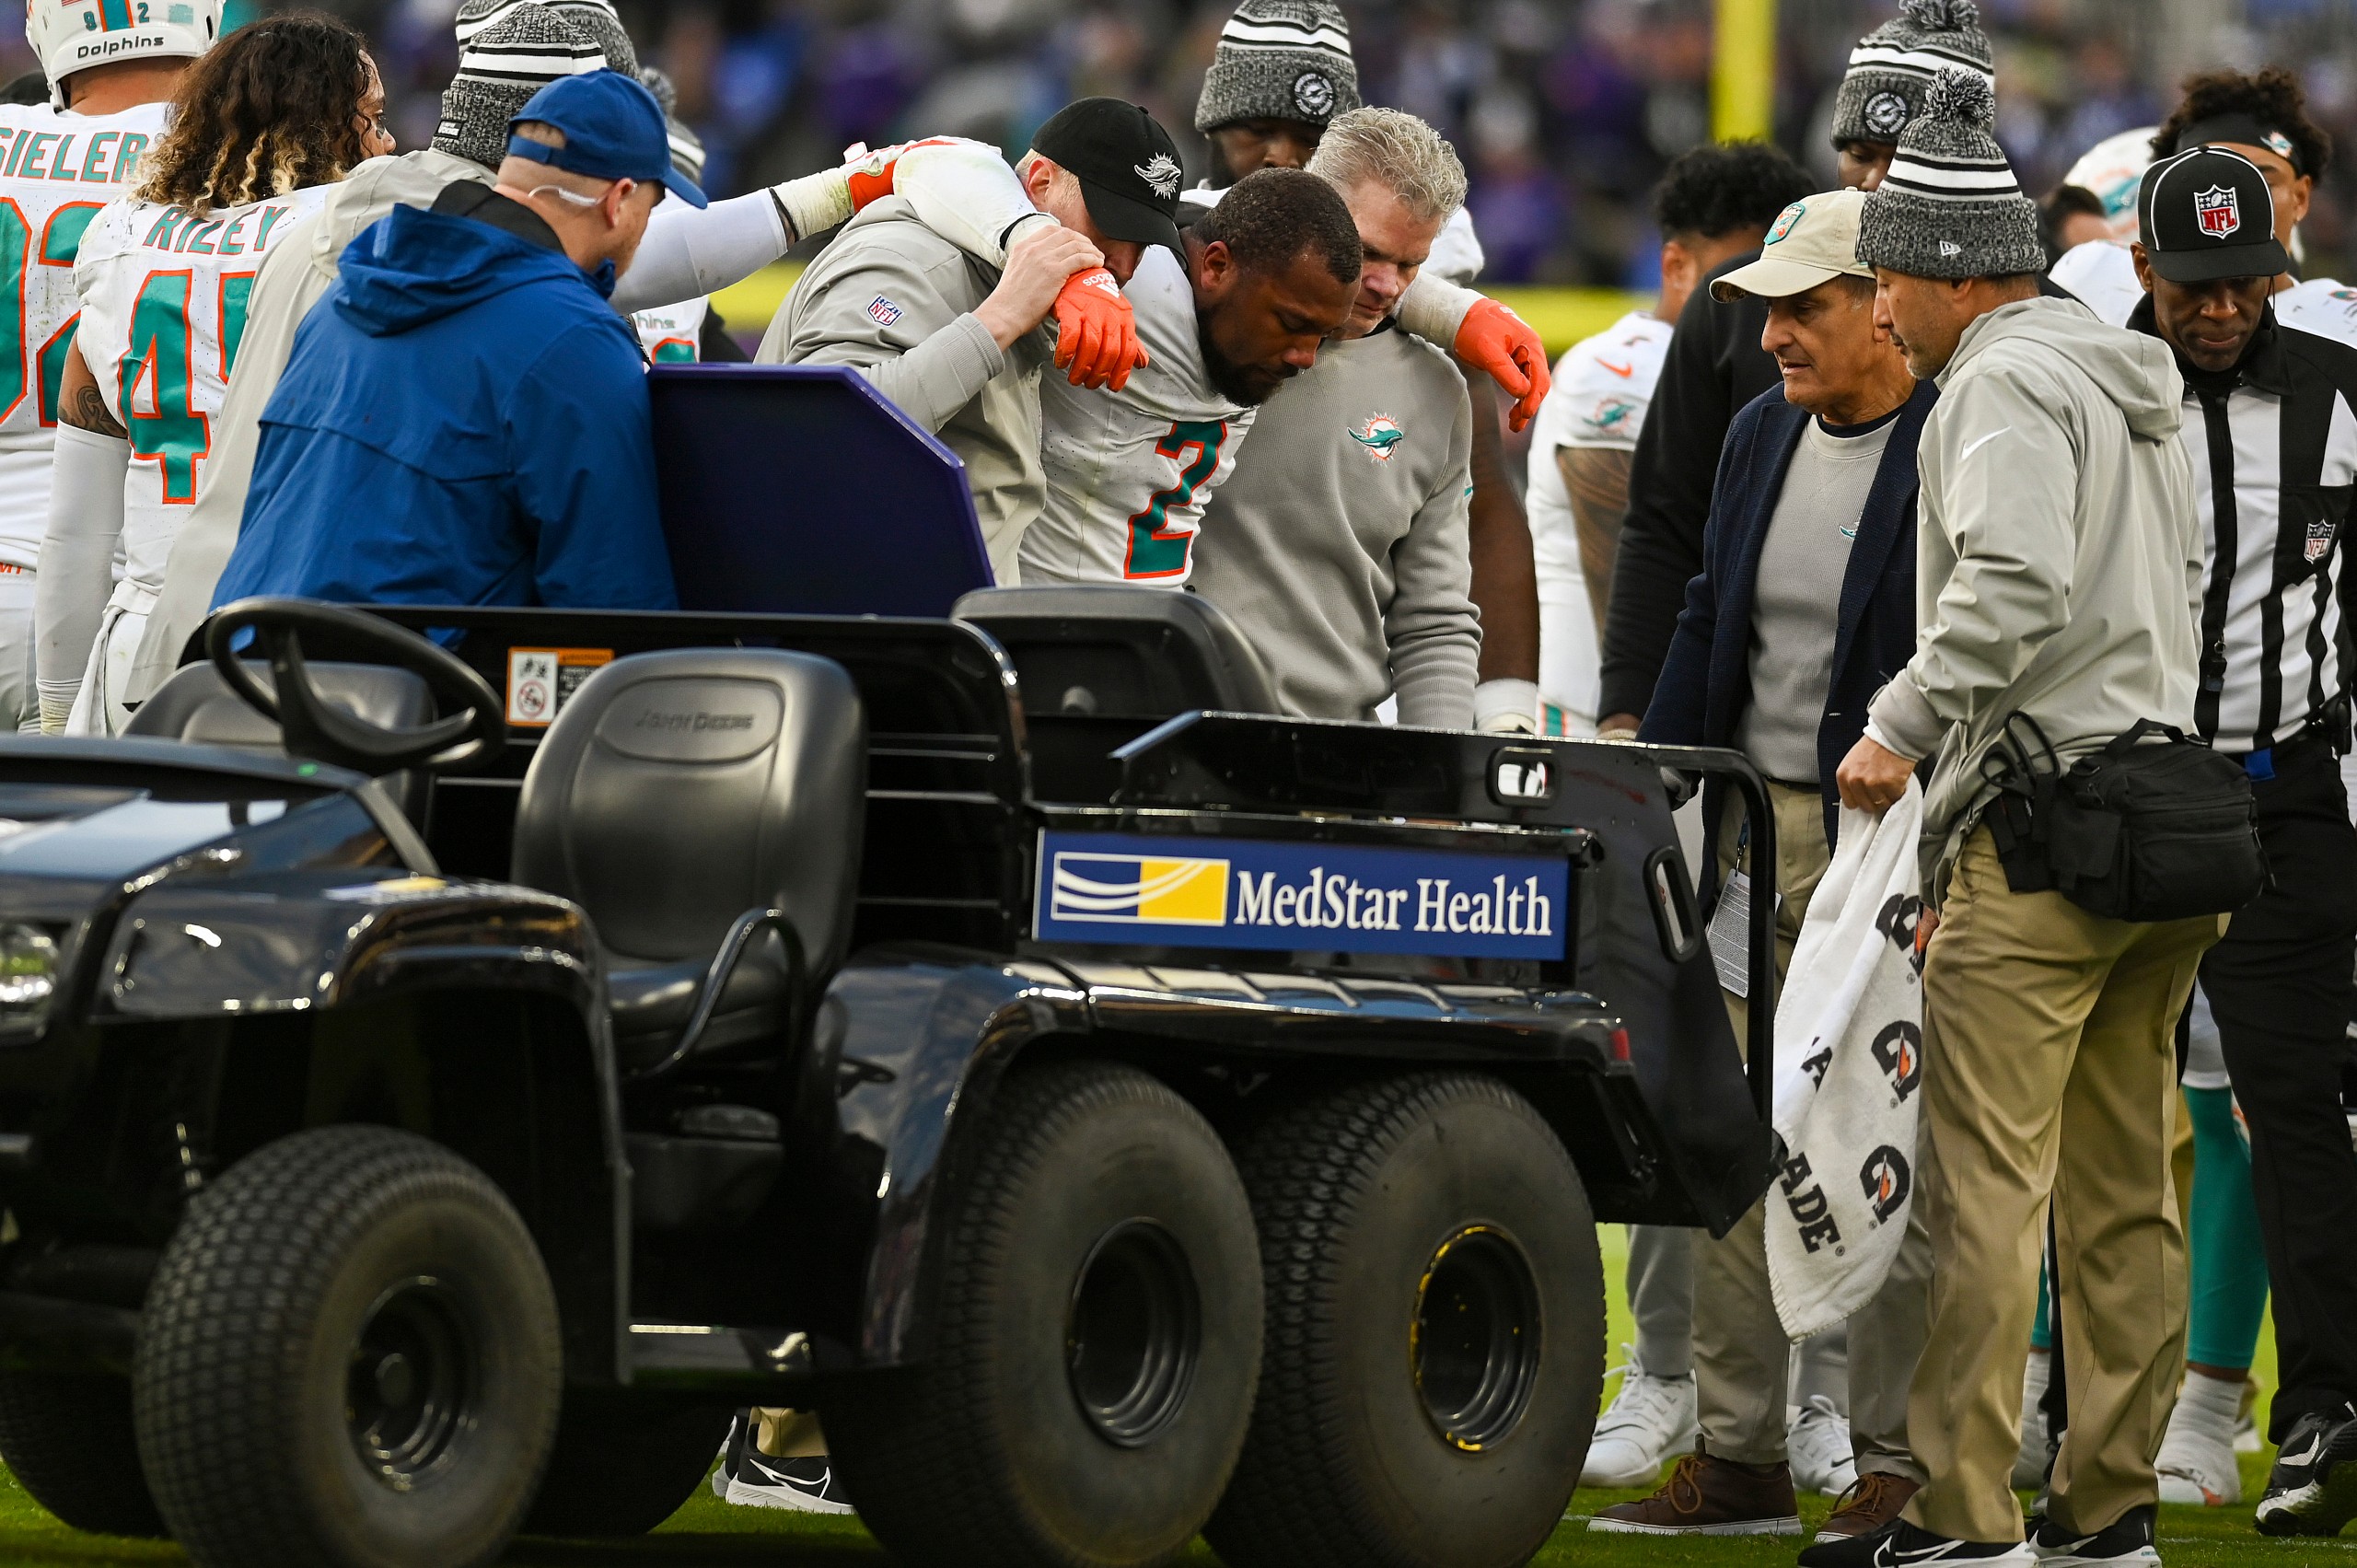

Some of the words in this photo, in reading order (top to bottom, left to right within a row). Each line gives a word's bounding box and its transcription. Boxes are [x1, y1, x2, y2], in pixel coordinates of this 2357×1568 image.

[136, 2, 150, 24] 2
[76, 35, 165, 59] Dolphins
[142, 205, 292, 256] RILEY
[2200, 207, 2236, 232] NFL
[870, 303, 893, 324] NFL
[1123, 419, 1228, 580] 2
[2305, 539, 2328, 558] NFL
[1233, 865, 1409, 932] MedStar
[1413, 874, 1553, 936] Health
